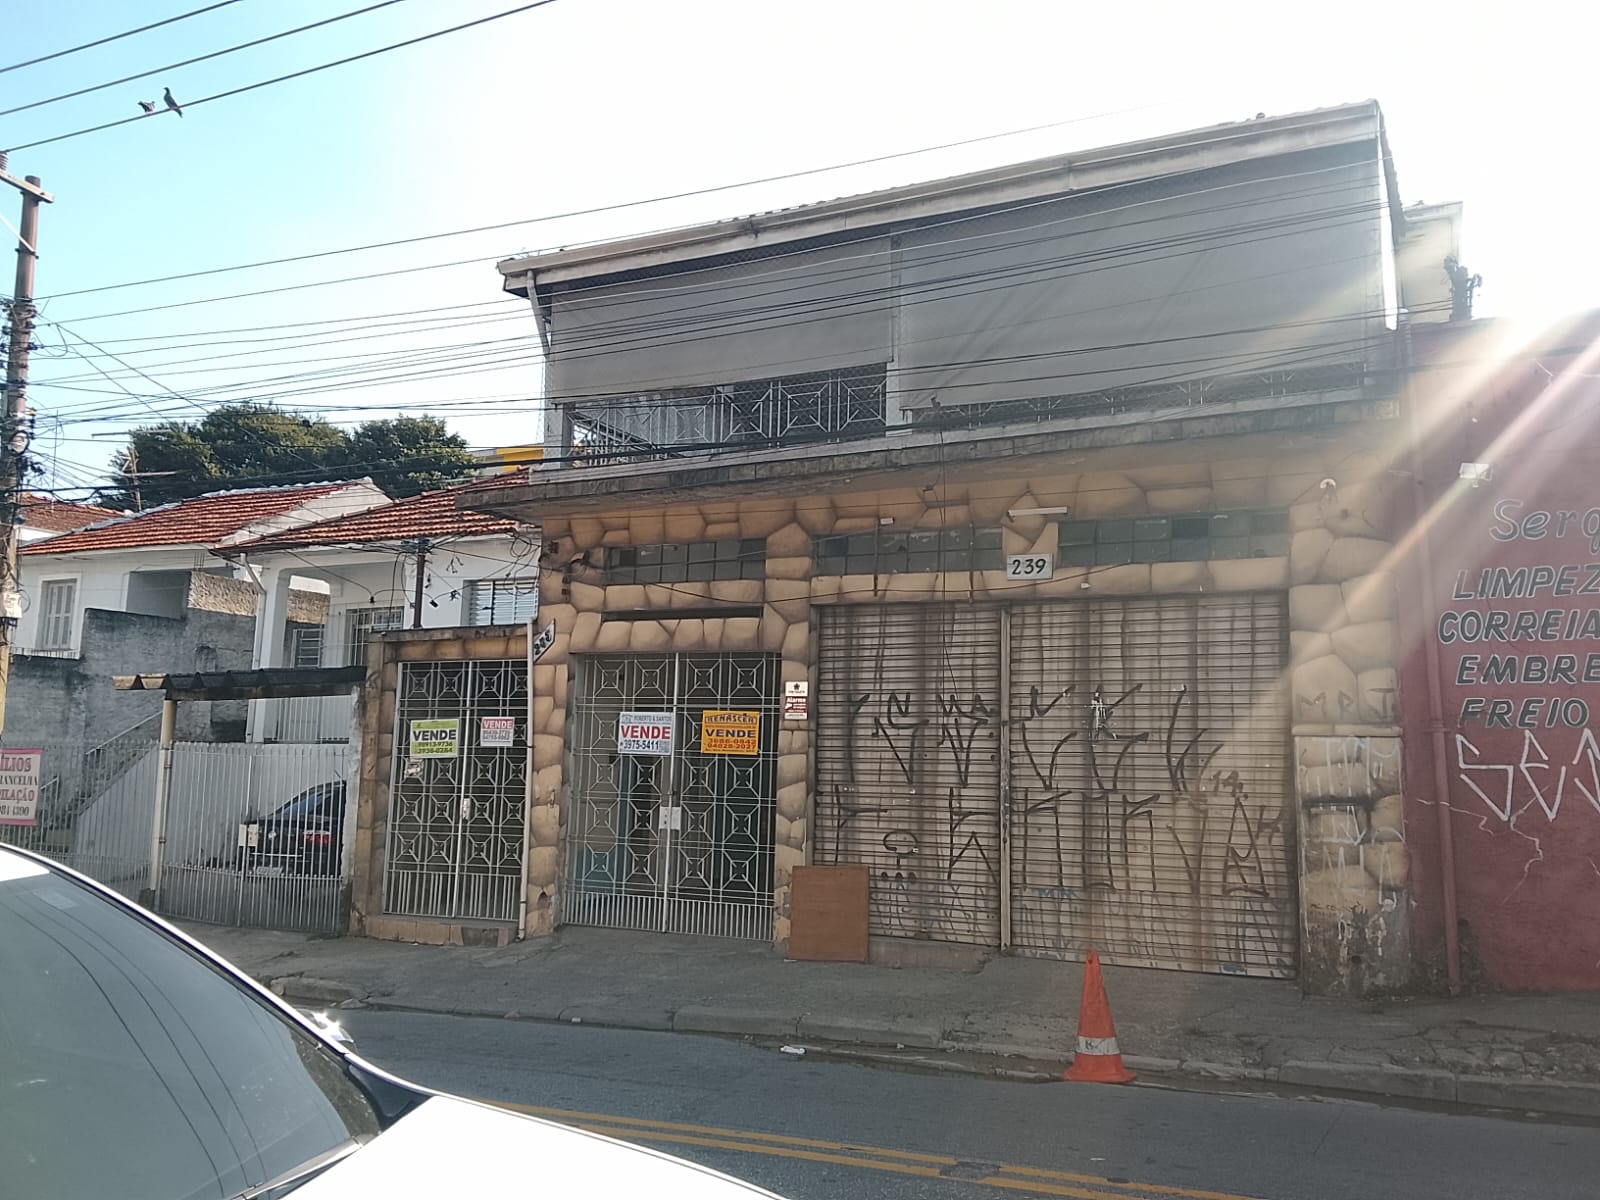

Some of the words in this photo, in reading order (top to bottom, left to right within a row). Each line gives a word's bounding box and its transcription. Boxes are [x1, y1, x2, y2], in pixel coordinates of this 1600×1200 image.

[1011, 558, 1047, 576] 239
[1452, 563, 1600, 600] LIMPEZ
[1437, 608, 1600, 645] CORREIA
[1455, 653, 1600, 686] EMBRE
[1456, 697, 1590, 729] FREIO
[483, 719, 513, 729] VENDE
[621, 725, 671, 739] VENDE
[413, 729, 456, 741] VENDE
[705, 729, 756, 738] VENDE
[624, 739, 659, 750] 3975-5411
